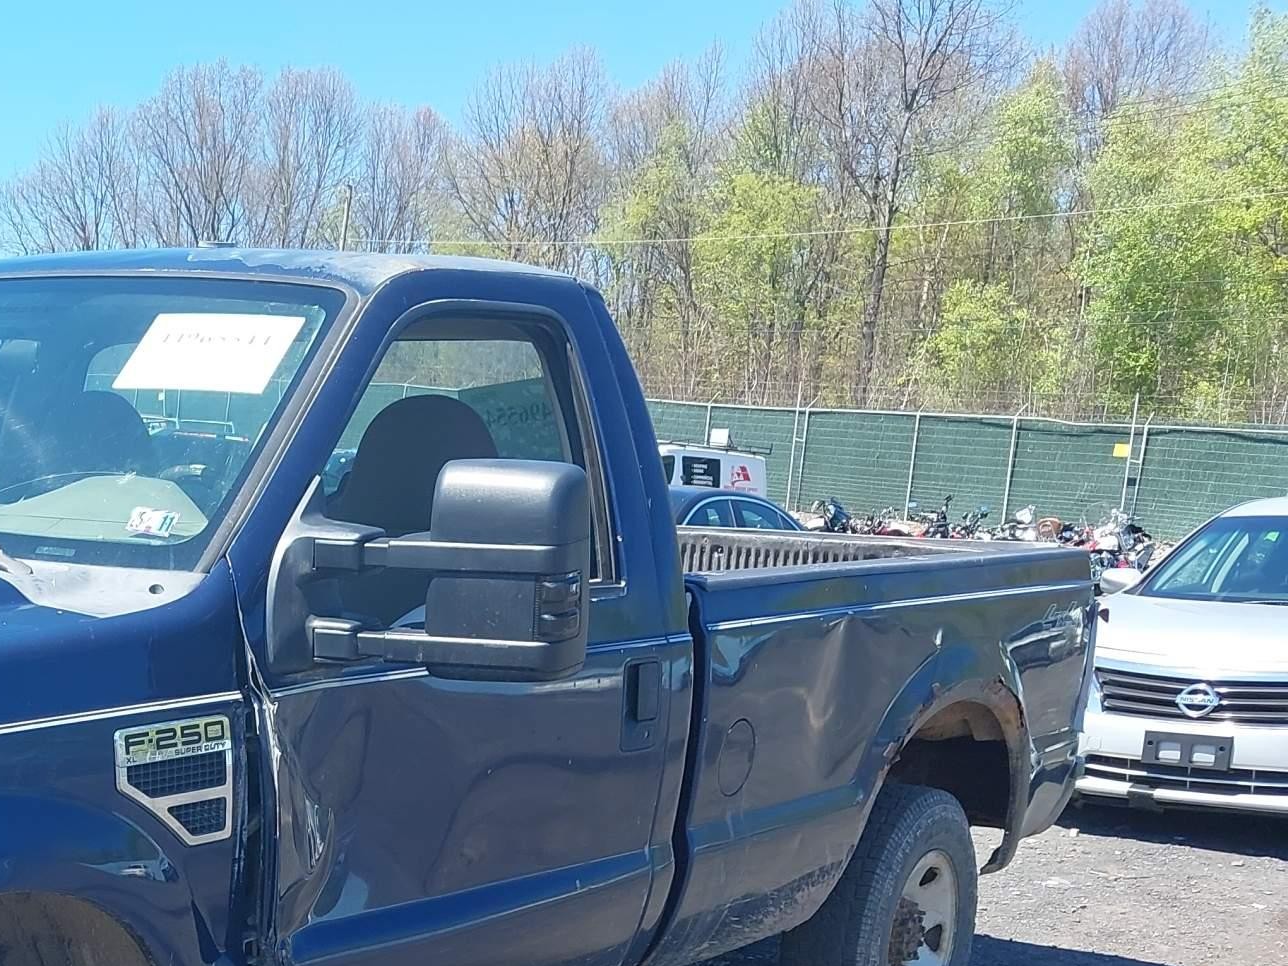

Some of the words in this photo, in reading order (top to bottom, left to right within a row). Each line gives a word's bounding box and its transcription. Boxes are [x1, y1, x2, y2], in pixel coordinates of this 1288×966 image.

[126, 755, 137, 765] XL
[174, 745, 203, 756] SUPER
[203, 740, 227, 752] DUTY
